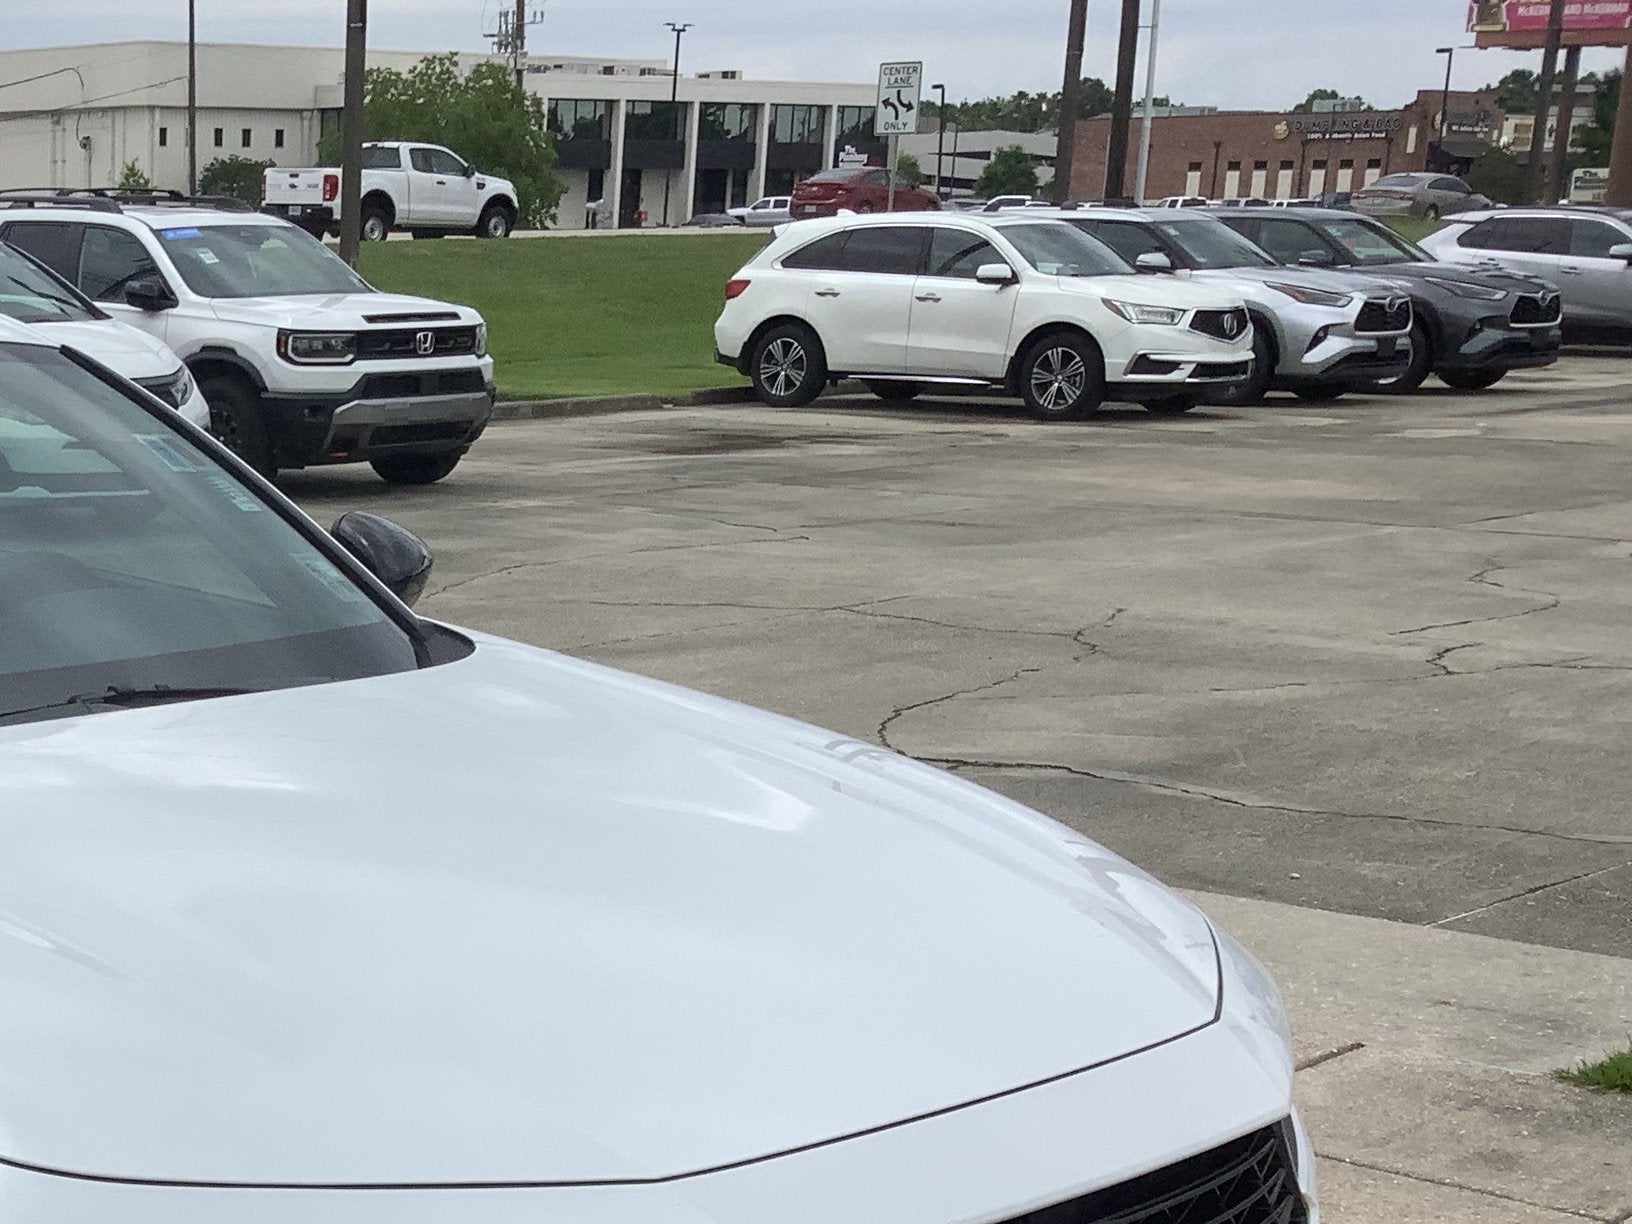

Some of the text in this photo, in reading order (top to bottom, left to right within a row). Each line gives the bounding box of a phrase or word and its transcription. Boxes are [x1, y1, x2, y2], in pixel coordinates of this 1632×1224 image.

[883, 65, 919, 76] CENTER
[888, 76, 912, 86] LANE
[883, 121, 909, 131] ONLY
